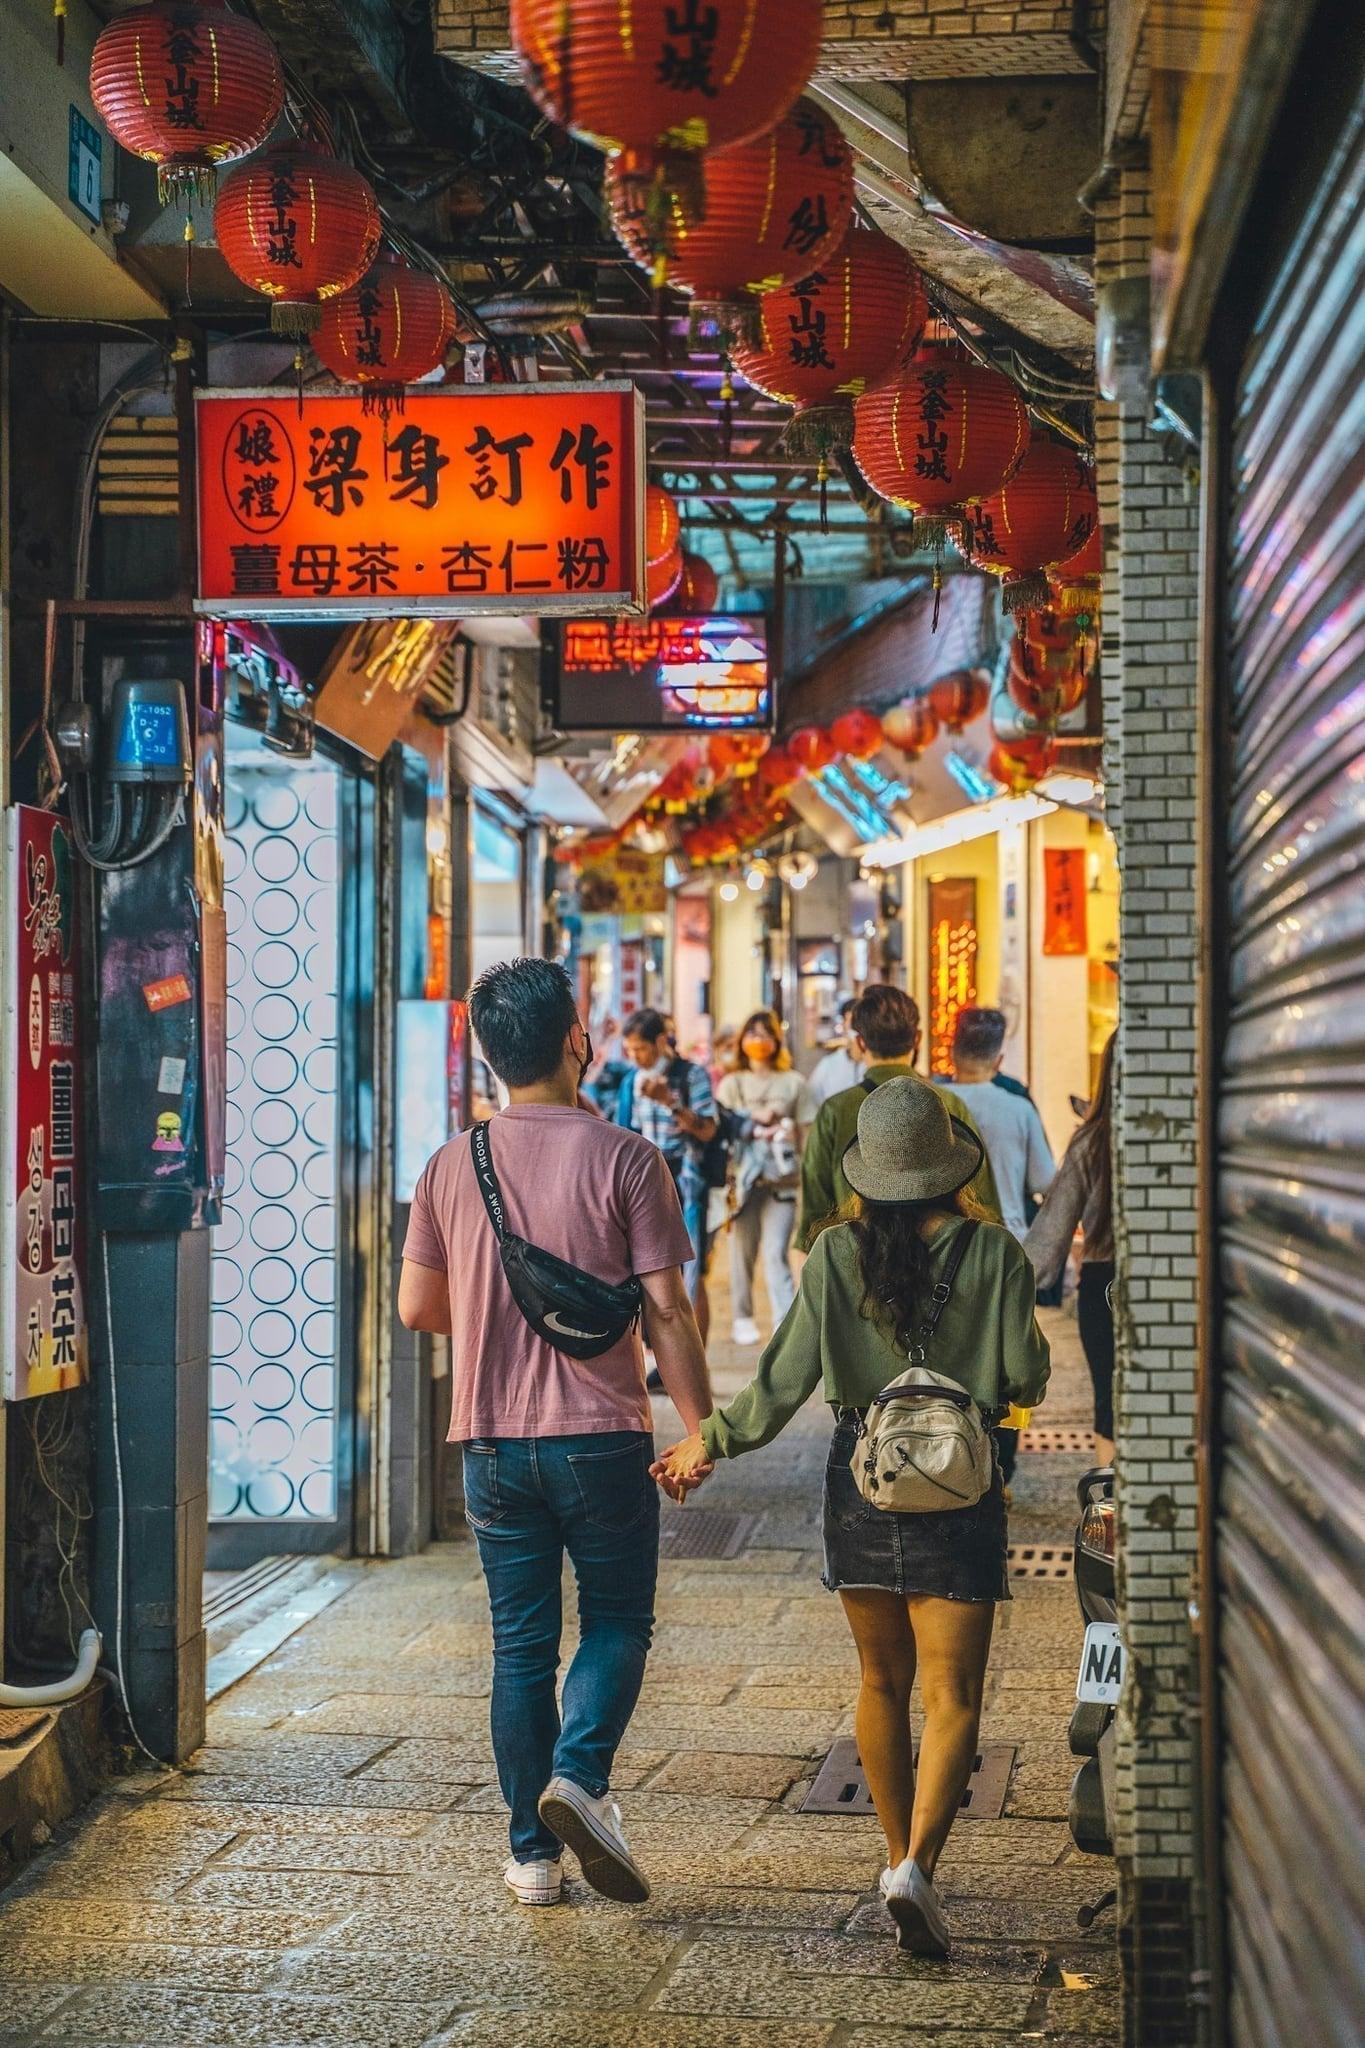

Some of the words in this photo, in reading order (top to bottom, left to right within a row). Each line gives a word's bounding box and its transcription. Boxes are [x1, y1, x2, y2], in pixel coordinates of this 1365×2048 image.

[86, 158, 94, 205] 6
[476, 1129, 488, 1169] SWOOSH
[488, 1192, 503, 1229] SWOO
